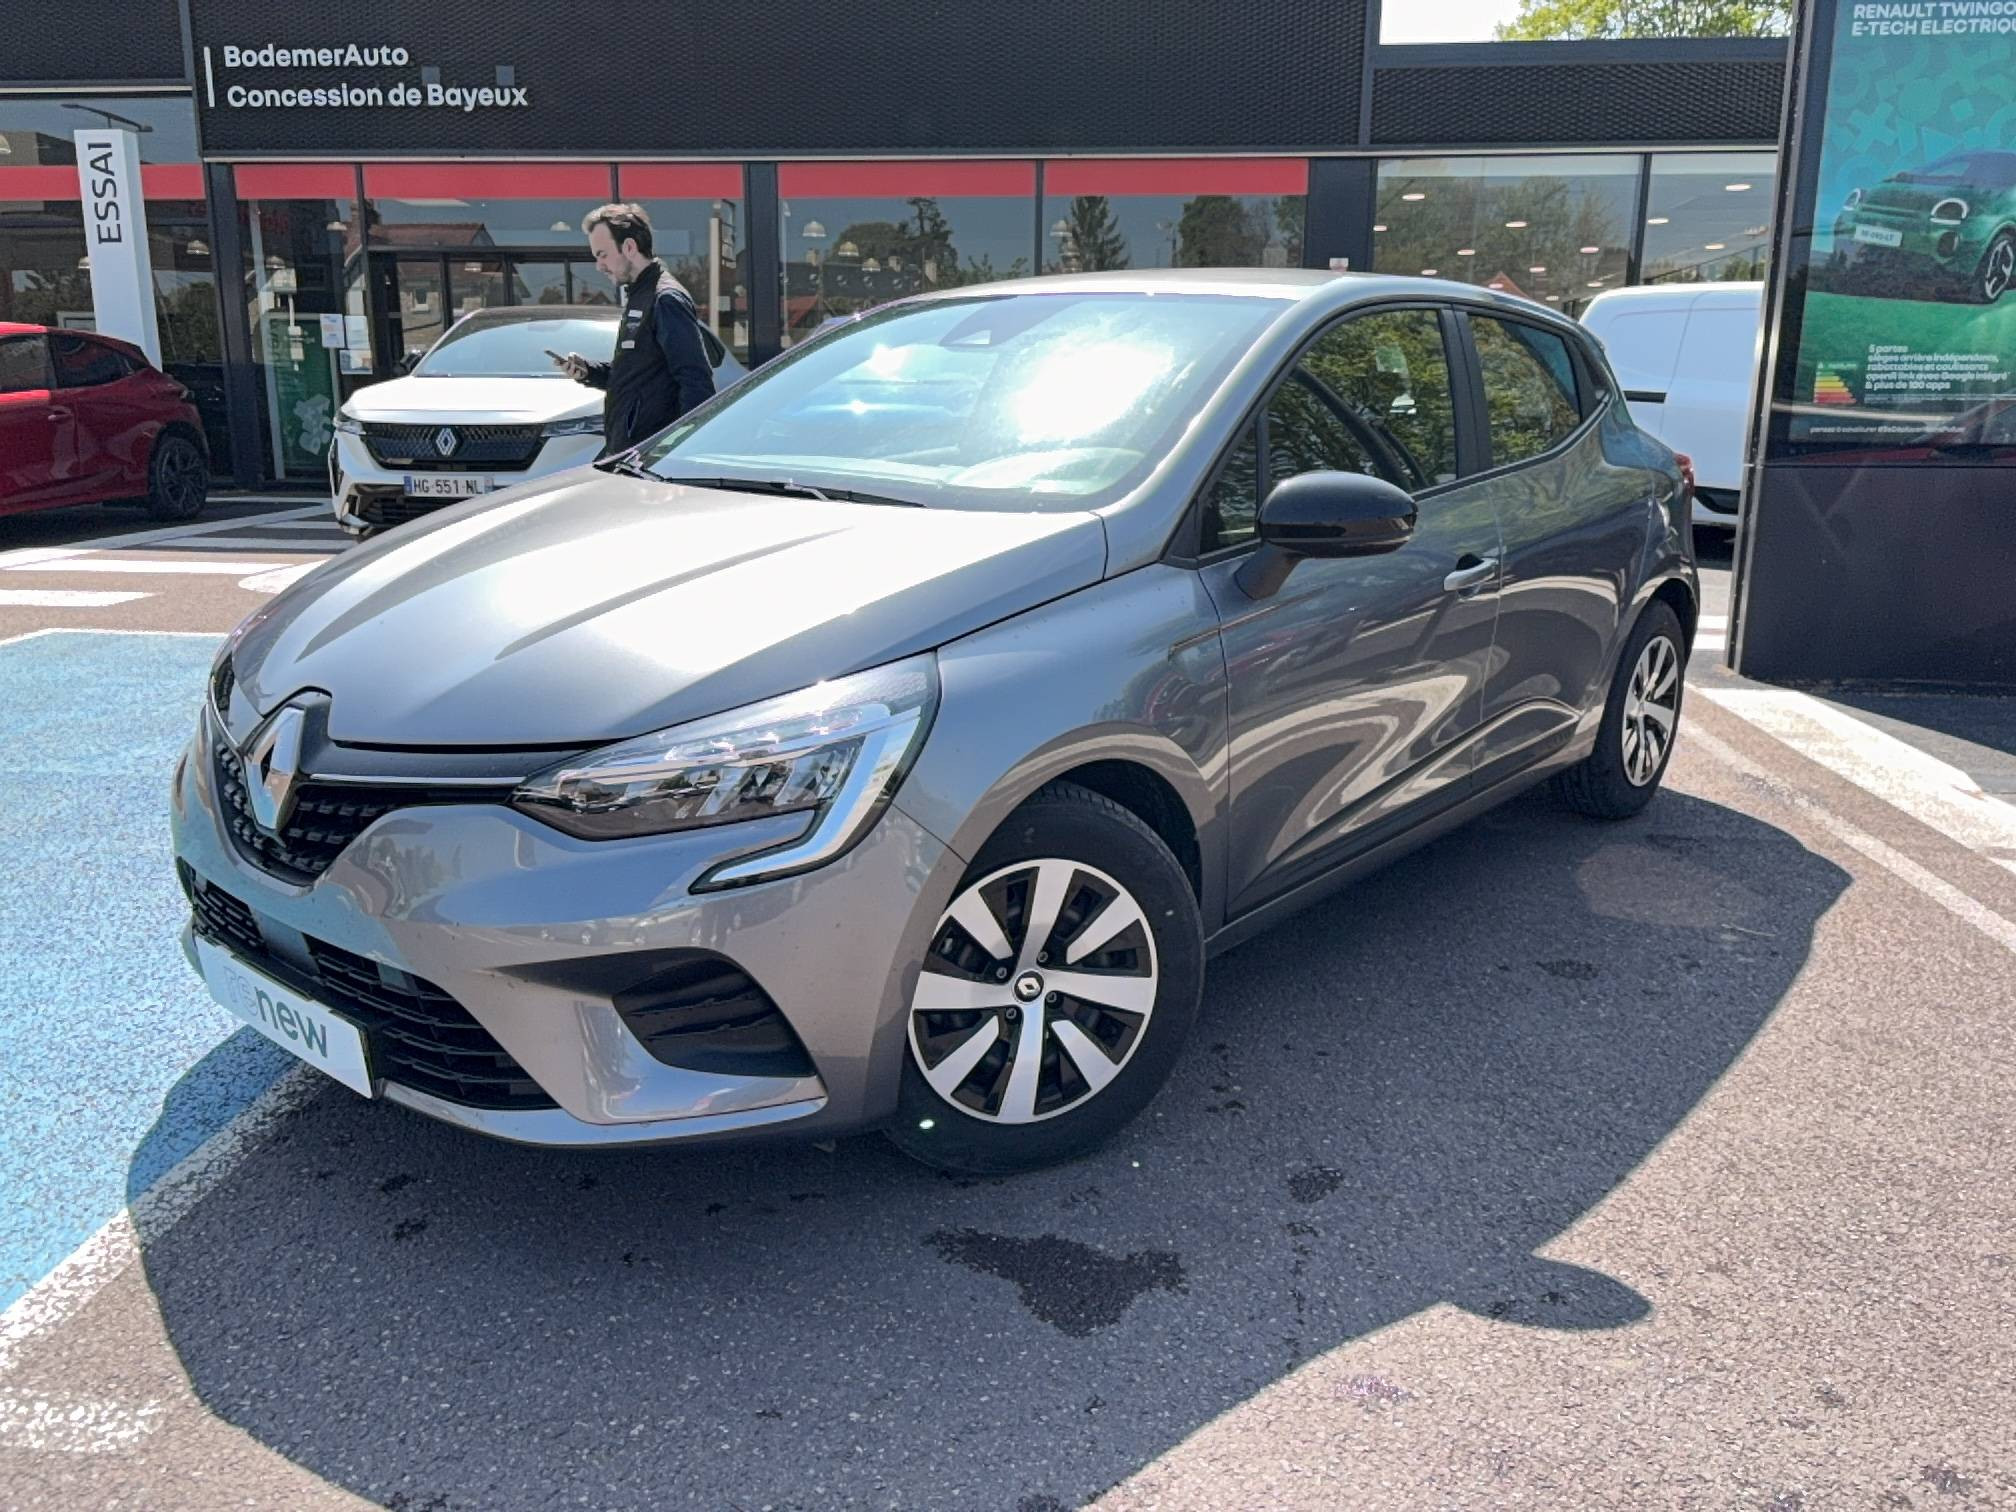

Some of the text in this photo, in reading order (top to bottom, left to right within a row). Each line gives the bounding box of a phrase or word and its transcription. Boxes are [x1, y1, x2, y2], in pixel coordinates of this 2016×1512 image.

[1853, 1, 2016, 19] RENAULT TWINGO
[1852, 20, 1918, 37] E-TECH
[223, 43, 409, 68] BodemerAuto
[226, 82, 528, 112] Concession de Bayeux
[88, 142, 123, 245] ESSAI
